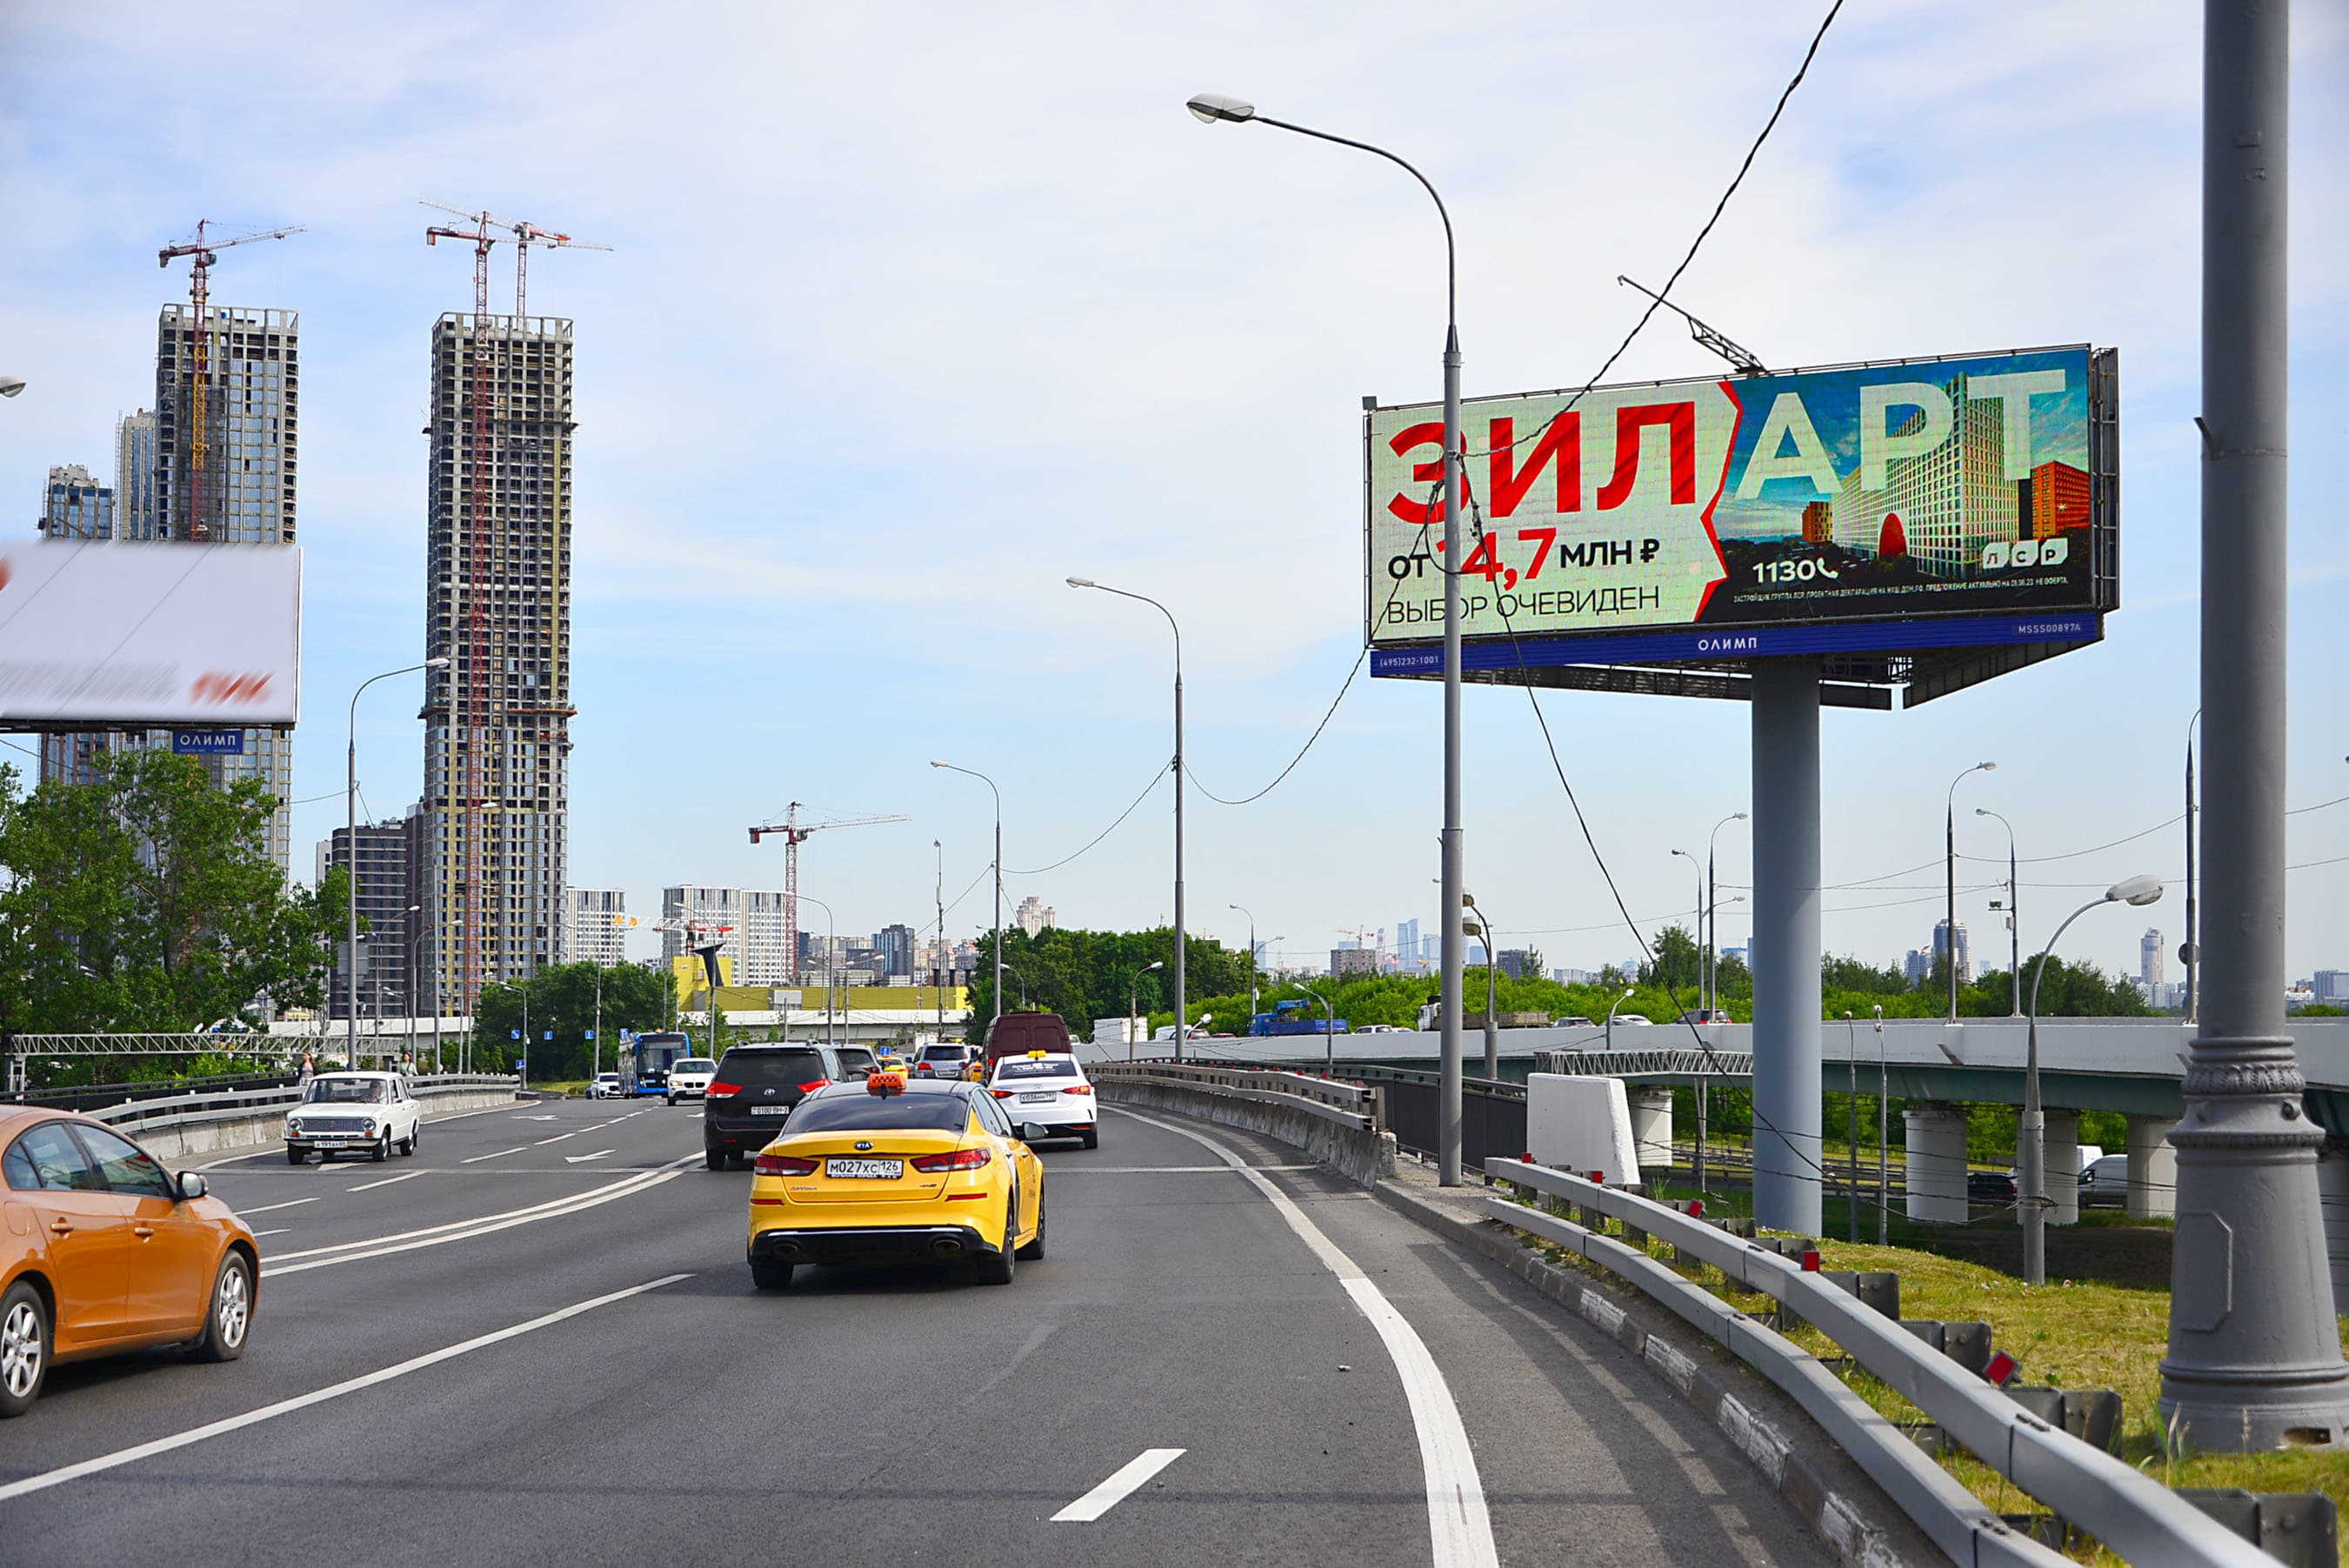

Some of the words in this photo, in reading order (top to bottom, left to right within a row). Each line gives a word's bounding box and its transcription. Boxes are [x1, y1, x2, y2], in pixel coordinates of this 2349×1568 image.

[1387, 401, 1696, 524] ЗИЛ
[1734, 368, 2066, 500] АРТ
[1388, 553, 1431, 580] ОТ
[1436, 527, 1557, 591] 4,7
[1560, 540, 1632, 569] МЛН
[1752, 559, 1816, 584] 1130
[1496, 585, 1660, 617] ОЧЕВИДЕН
[2019, 624, 2081, 634] MSSS00897A
[1698, 637, 1757, 651] ОЛИМП
[1379, 656, 1438, 668] (495)232-1001
[180, 734, 236, 745] ОЛИМП
